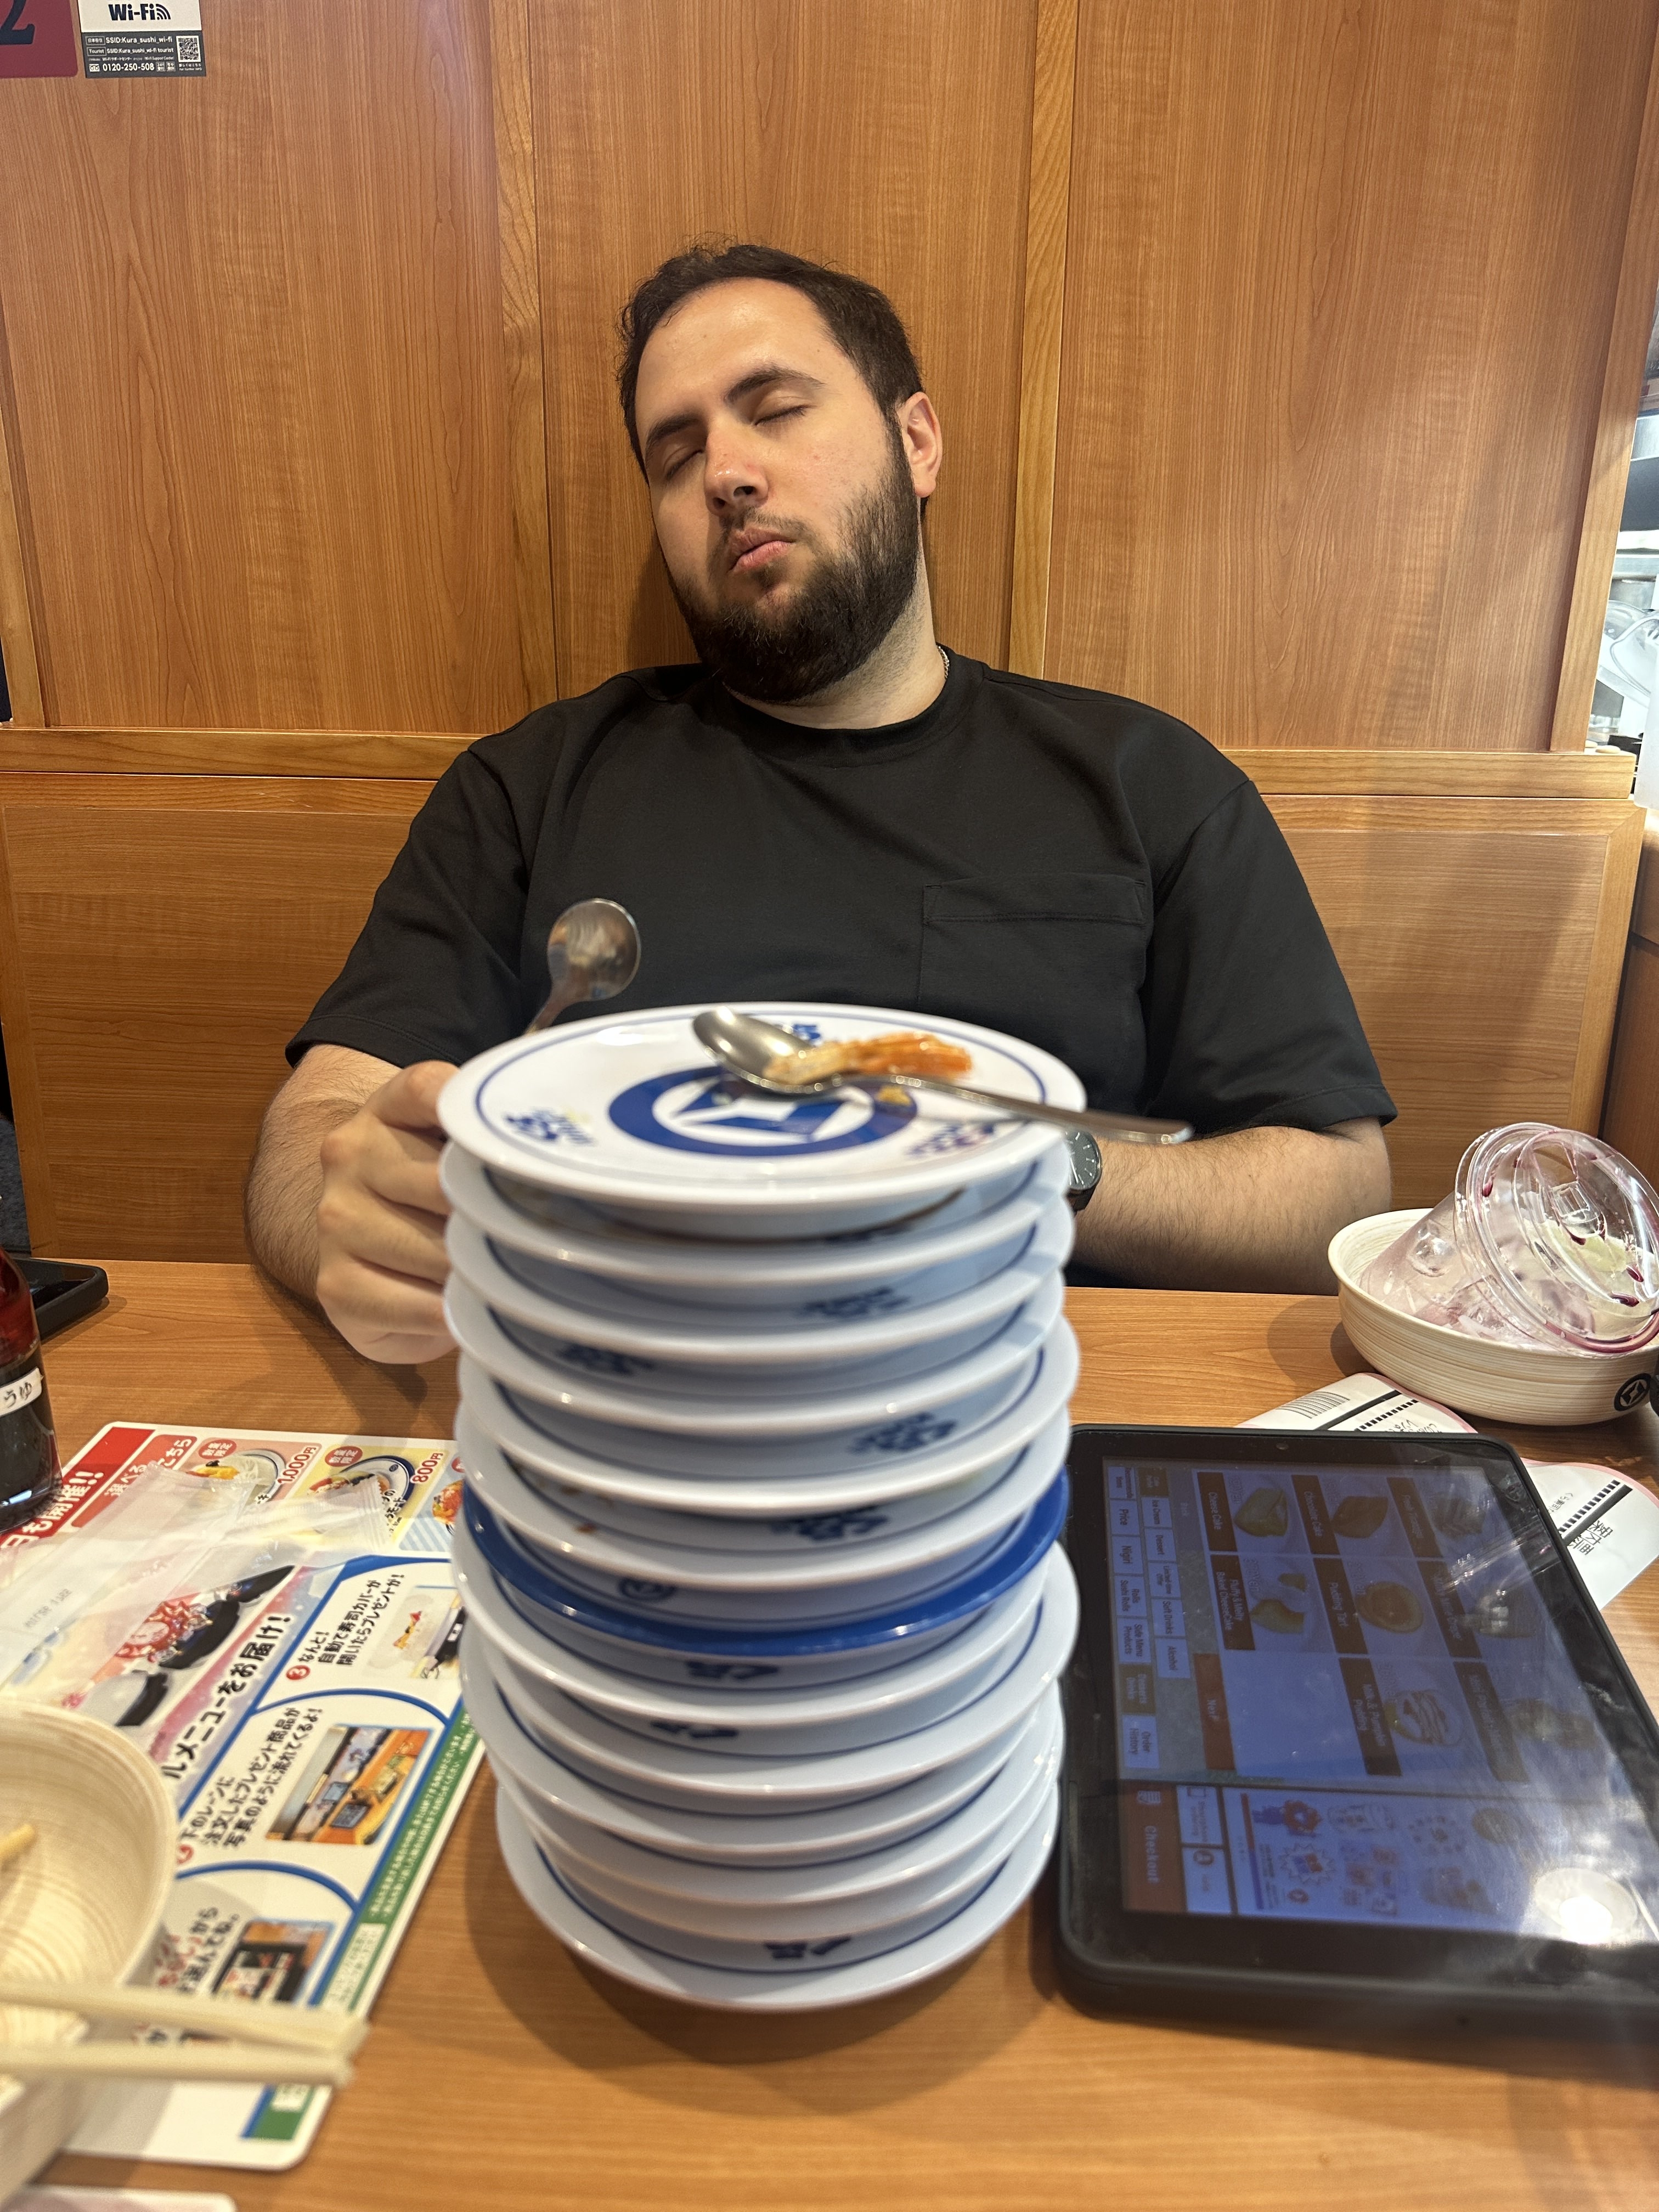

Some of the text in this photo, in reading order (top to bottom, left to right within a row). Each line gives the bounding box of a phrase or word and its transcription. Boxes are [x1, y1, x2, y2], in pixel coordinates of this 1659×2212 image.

[108, 4, 155, 21] Wi-Fi
[106, 36, 172, 44] SSID:Kura_sushi_wi-fi
[103, 63, 155, 71] 0120-250-508
[277, 1446, 317, 1483] 1,000円
[410, 1453, 443, 1483] 800円
[1119, 1509, 1129, 1526] Price
[1153, 1508, 1161, 1525] Cream
[1207, 1492, 1223, 1530] Cheese Cake
[1304, 1491, 1323, 1537] Chocolate Cake
[1119, 1545, 1133, 1564] Nigiri
[1155, 1534, 1165, 1555] Dessert
[1215, 1571, 1227, 1591] Baked
[1228, 1579, 1241, 1598] Fluffy
[1120, 1579, 1131, 1612] Sushi Rolls
[1131, 1588, 1141, 1604] Rolls
[1328, 1582, 1348, 1628] Pudding Tart
[318, 1579, 381, 1664] 自動で寿司カバーが
[336, 1574, 405, 1666] 開いたらプレゼントが!
[1162, 1601, 1174, 1634] Soft Drinks
[298, 1631, 330, 1663] なんと!
[1123, 1626, 1132, 1655] Products
[1134, 1623, 1144, 1657] Side Menu
[1167, 1645, 1178, 1671] Alcohol
[1128, 1728, 1140, 1756] History
[1141, 1731, 1153, 1753] Order
[1144, 1825, 1161, 1884] Checkout
